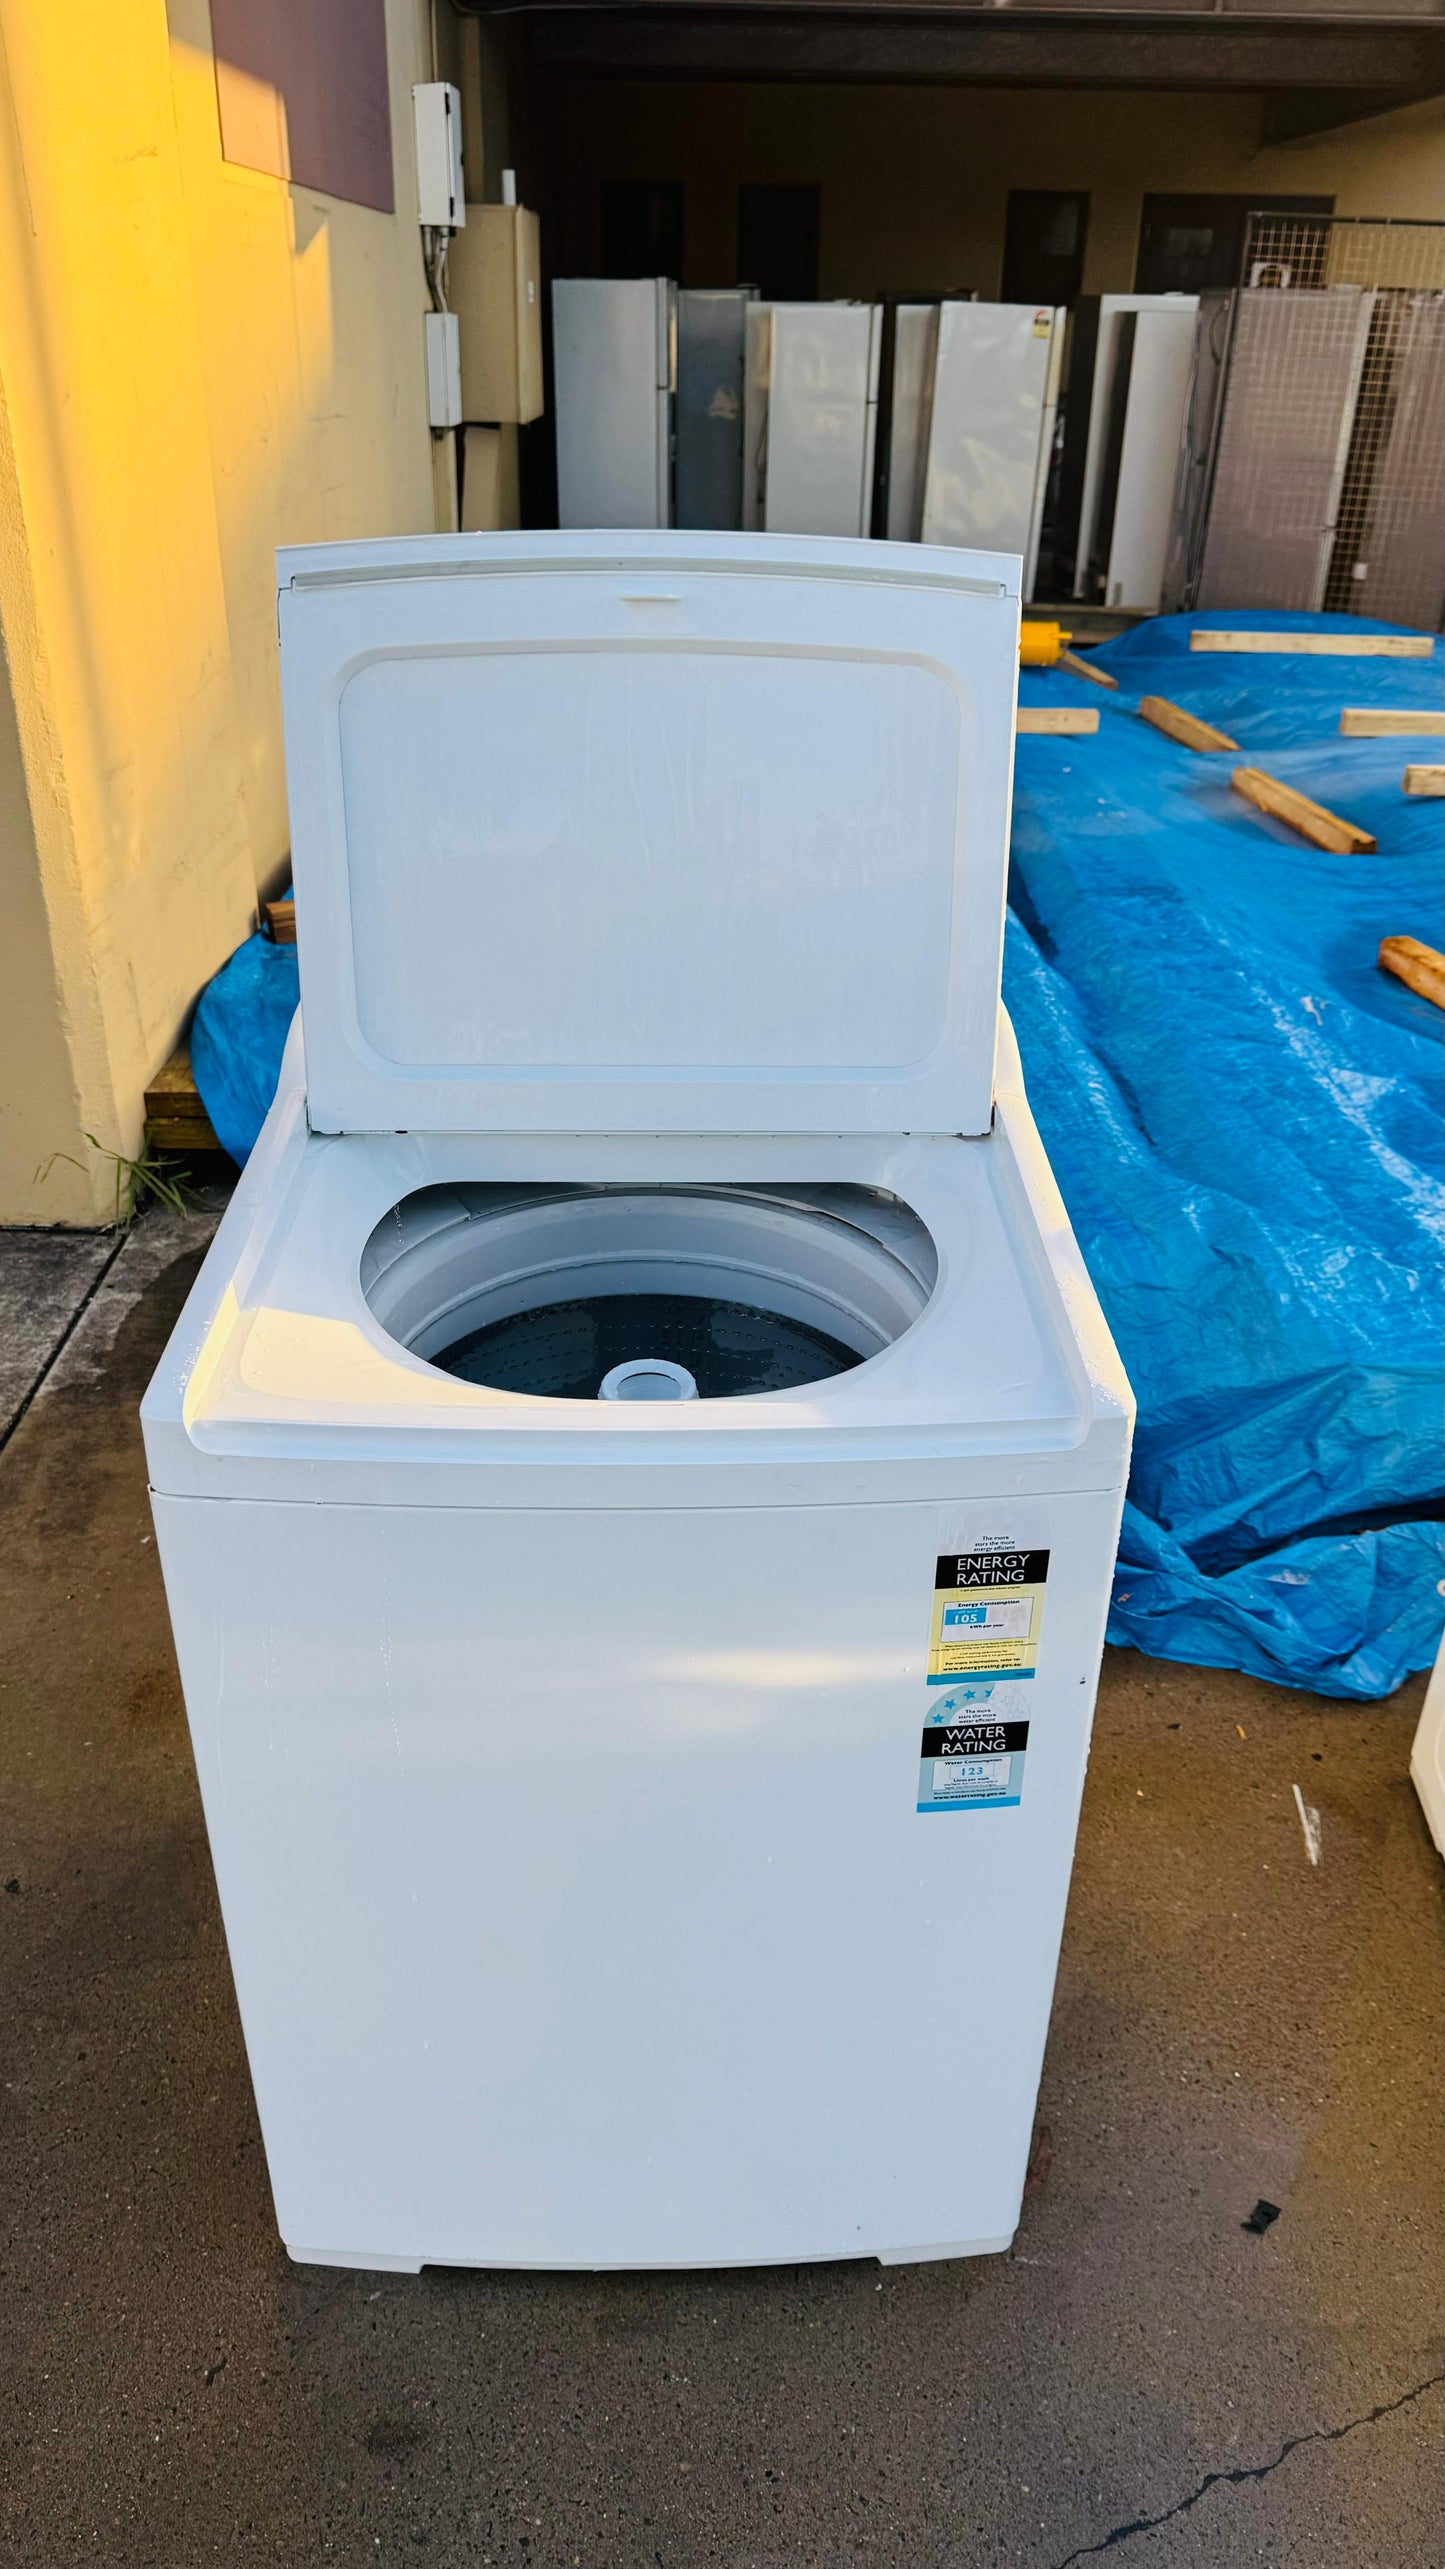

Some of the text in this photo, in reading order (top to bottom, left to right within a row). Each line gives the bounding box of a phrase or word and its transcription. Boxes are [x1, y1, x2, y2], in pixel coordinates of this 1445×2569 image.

[957, 1554, 1031, 1571] ENERGY
[956, 1569, 1025, 1586] RATING
[954, 1614, 978, 1624] 105
[942, 1663, 1022, 1671] www.energyrating.gov.au
[945, 1726, 1006, 1740] WATER
[941, 1739, 1006, 1755] RATING
[961, 1767, 984, 1776] 123
